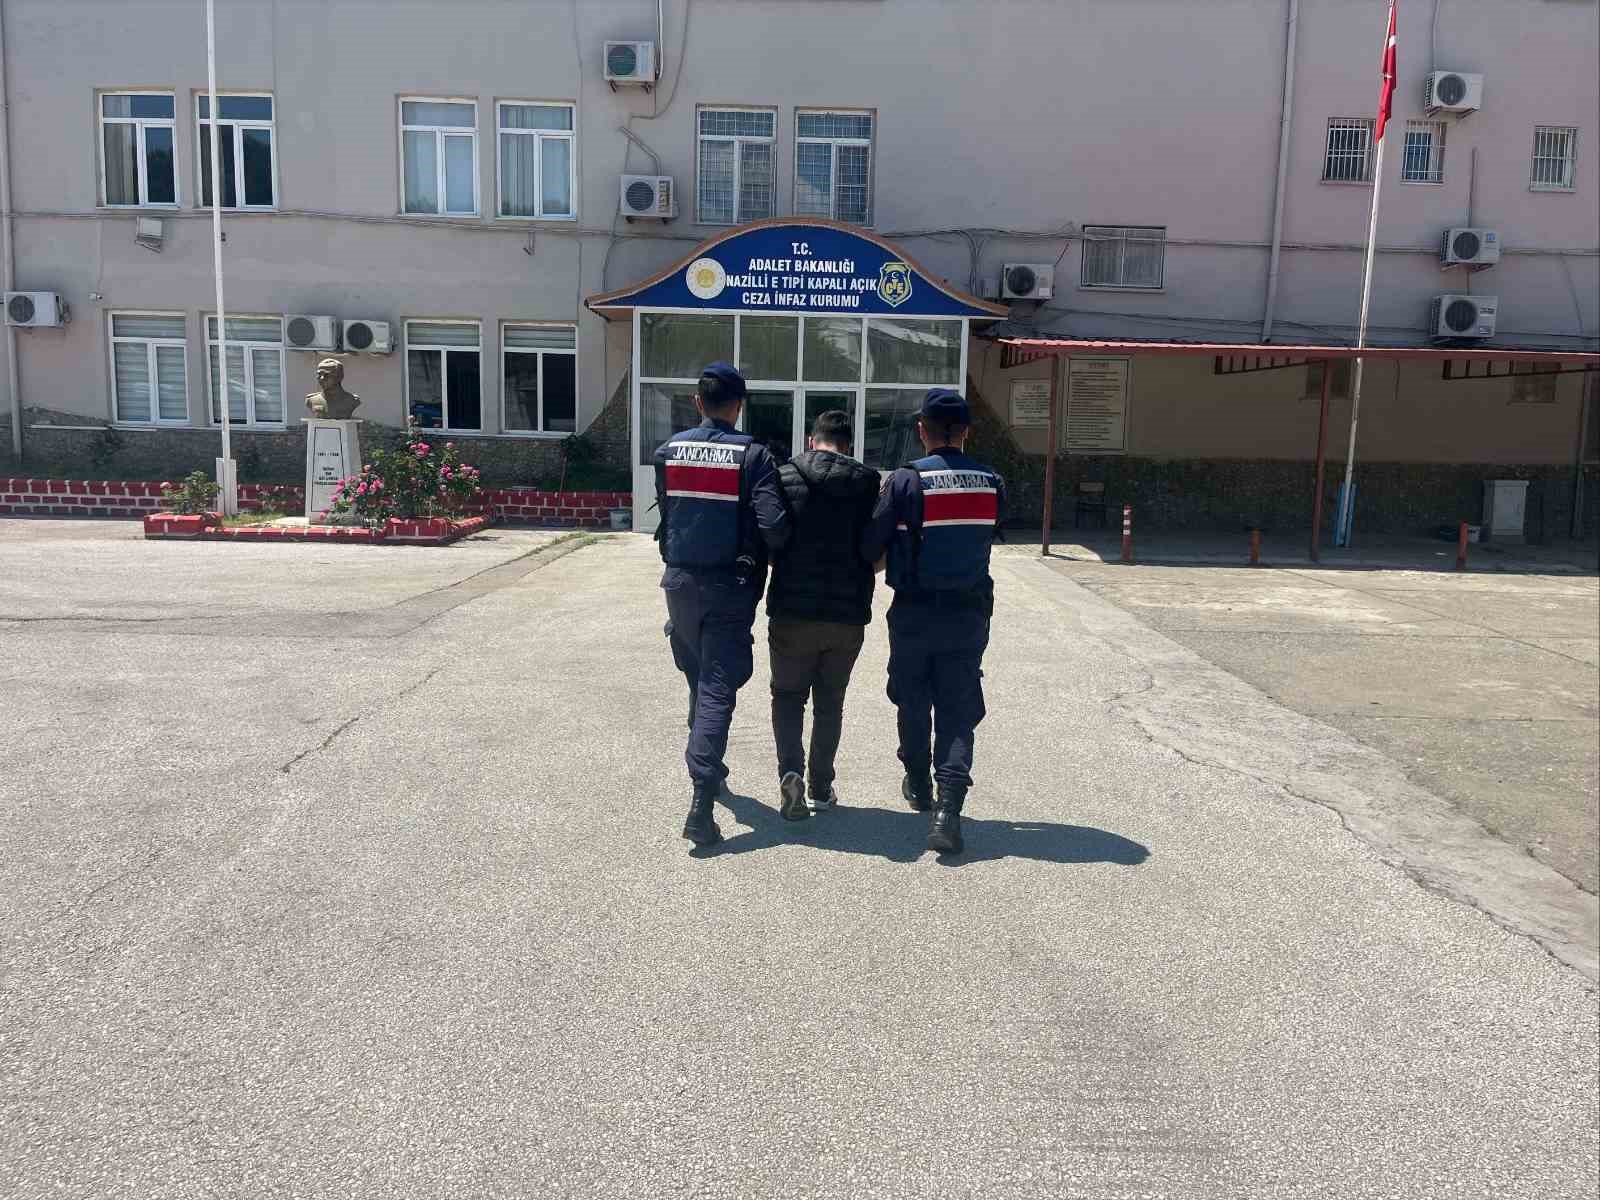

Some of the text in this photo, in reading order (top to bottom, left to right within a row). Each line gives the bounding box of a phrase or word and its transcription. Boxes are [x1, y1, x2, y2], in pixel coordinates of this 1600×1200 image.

[792, 242, 812, 255] T.C.
[749, 258, 854, 273] ADALET BAKANLIĞI
[726, 273, 768, 288] NAZİLLİ
[772, 276, 778, 288] E
[808, 277, 847, 290] KAPALI
[850, 278, 877, 294] AÇIK
[742, 291, 860, 307] CEZA İNFAZ KURUMU
[672, 446, 734, 463] JANDARMA
[930, 473, 990, 489] JANDARMA
